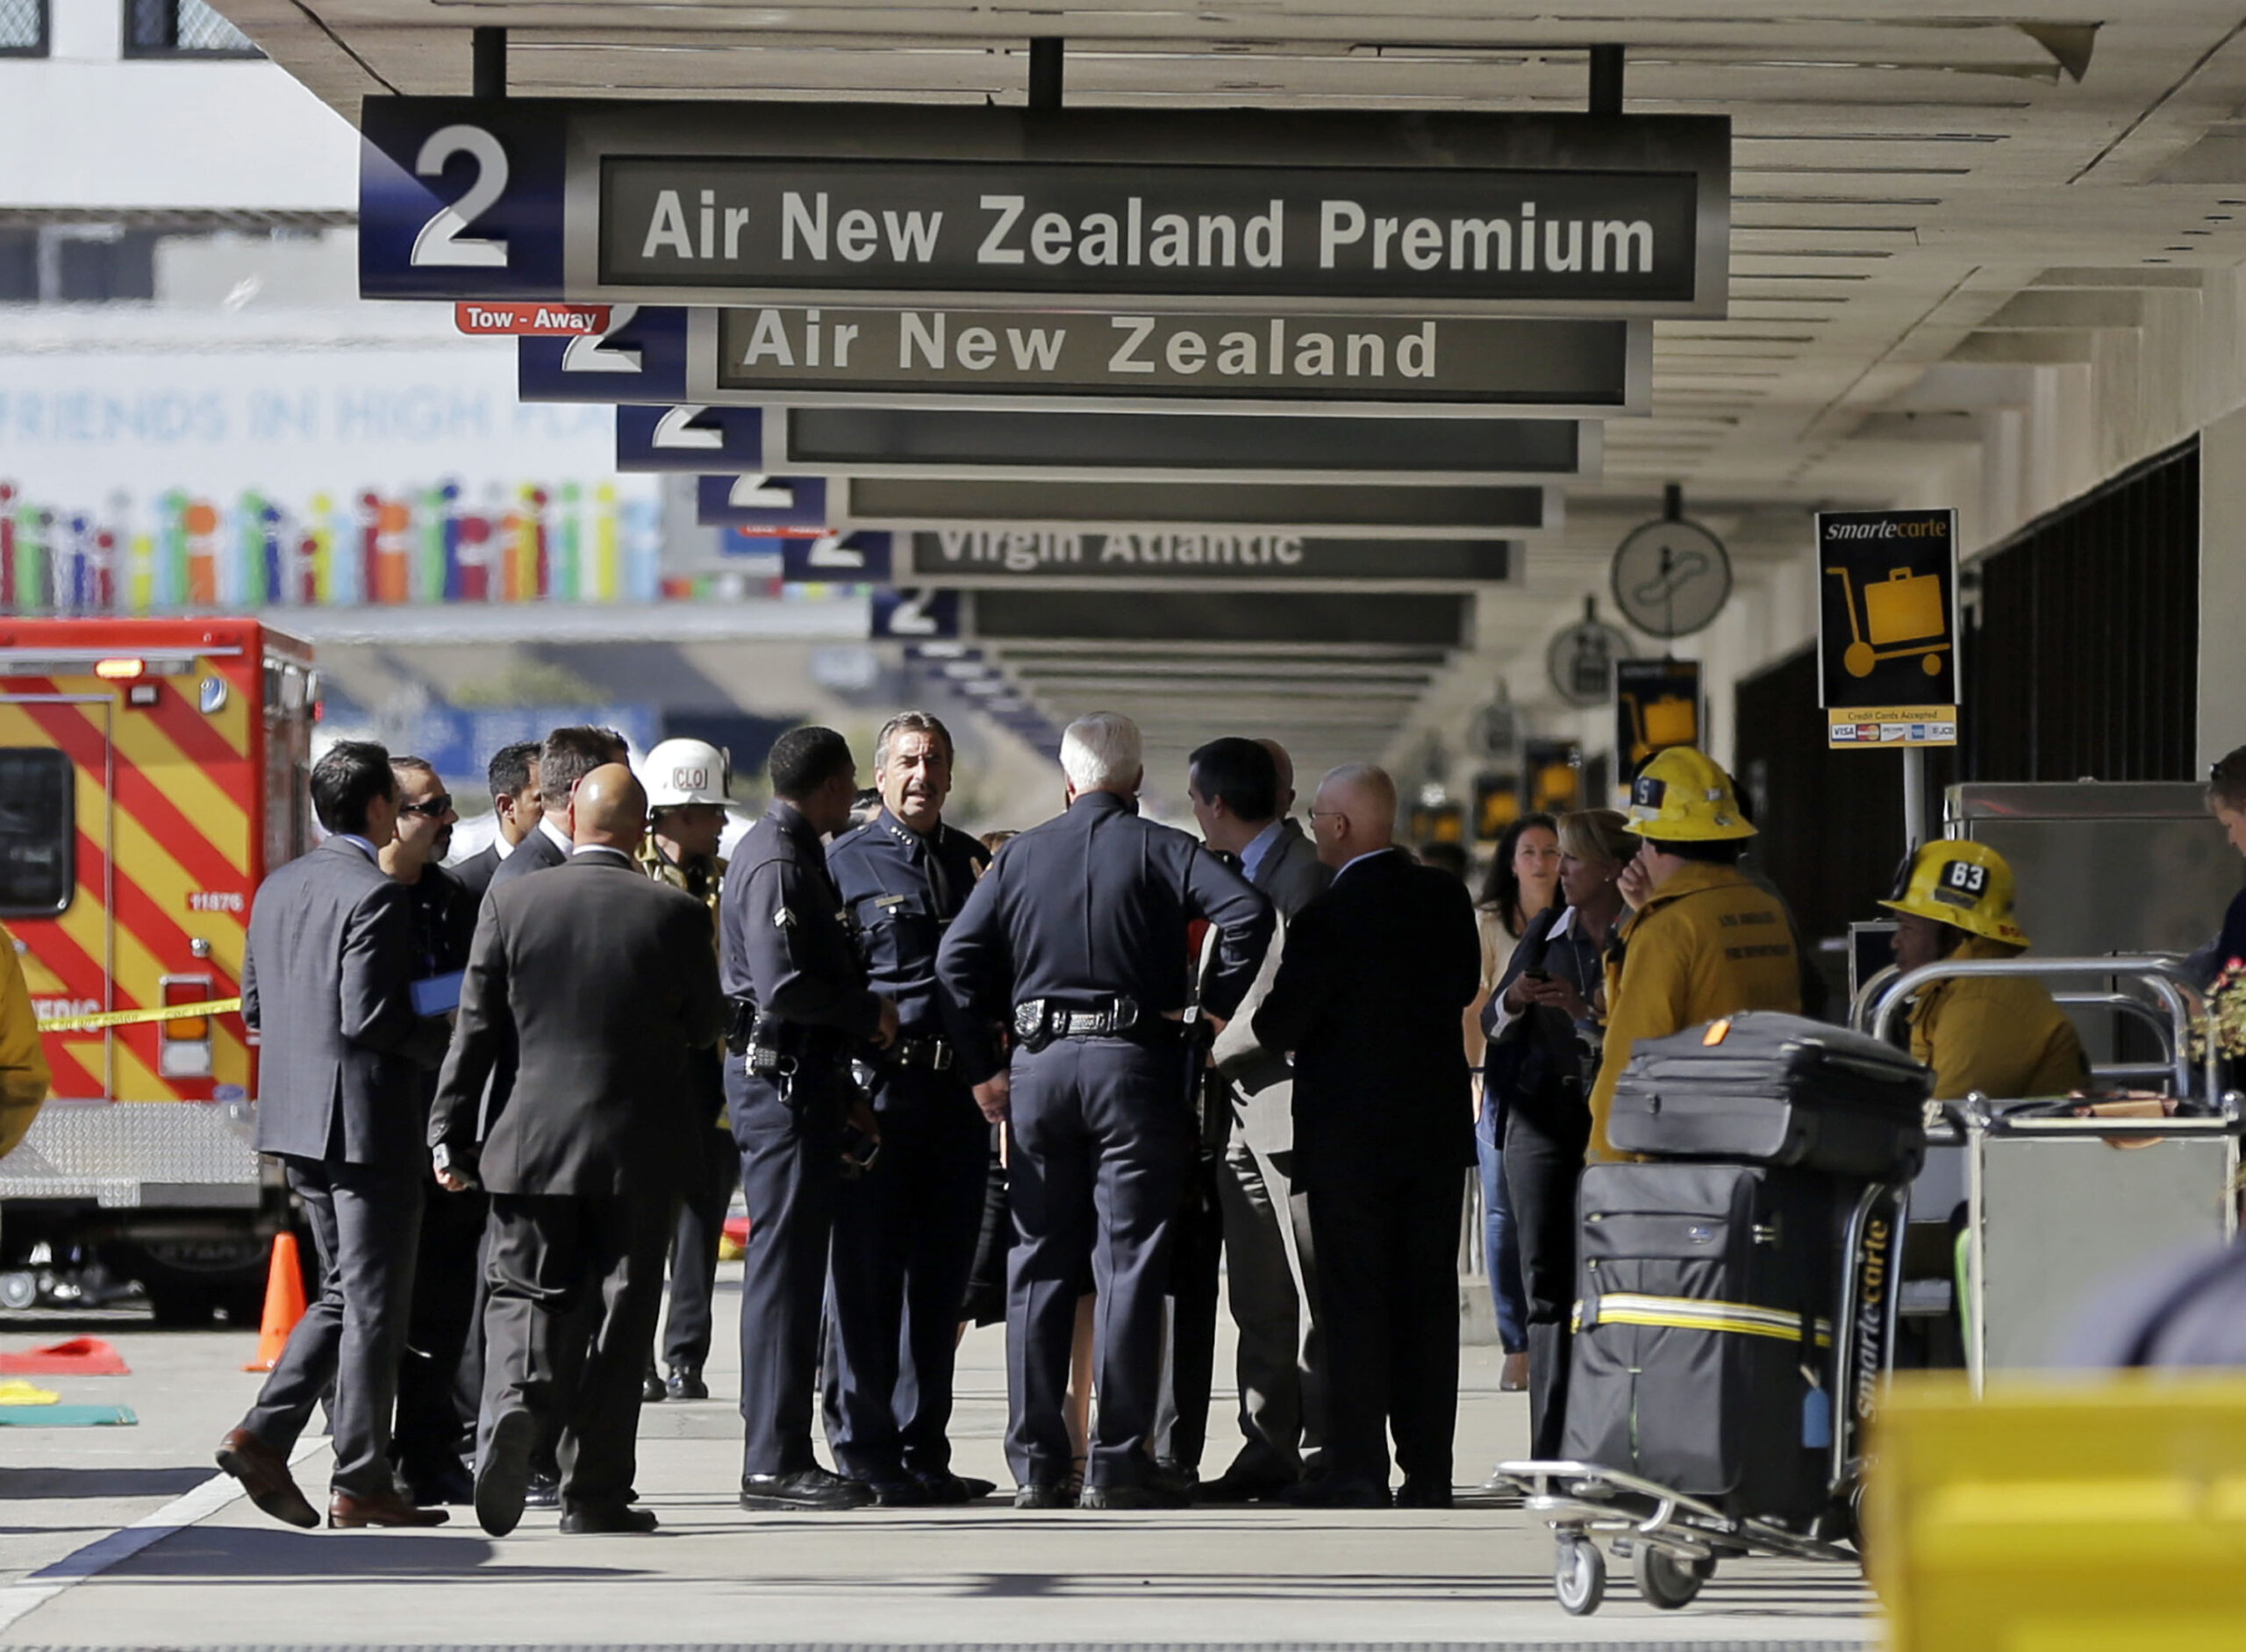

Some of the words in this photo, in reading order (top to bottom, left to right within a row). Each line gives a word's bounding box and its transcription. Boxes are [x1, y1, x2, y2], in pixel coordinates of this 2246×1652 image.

[411, 124, 509, 267] 2
[641, 190, 749, 261] Air
[781, 191, 943, 267] New
[976, 195, 1284, 269] Zealand
[1318, 200, 1655, 274] Premium
[467, 308, 513, 328] Tow
[533, 309, 597, 333] Away
[744, 309, 859, 368] Air
[899, 311, 1066, 372] New
[1108, 317, 1437, 378] Zealand
[936, 529, 1084, 571] Virgin
[1100, 533, 1305, 564] Atlantic
[1825, 518, 1947, 540] smartecarte
[1950, 862, 1985, 891] 63
